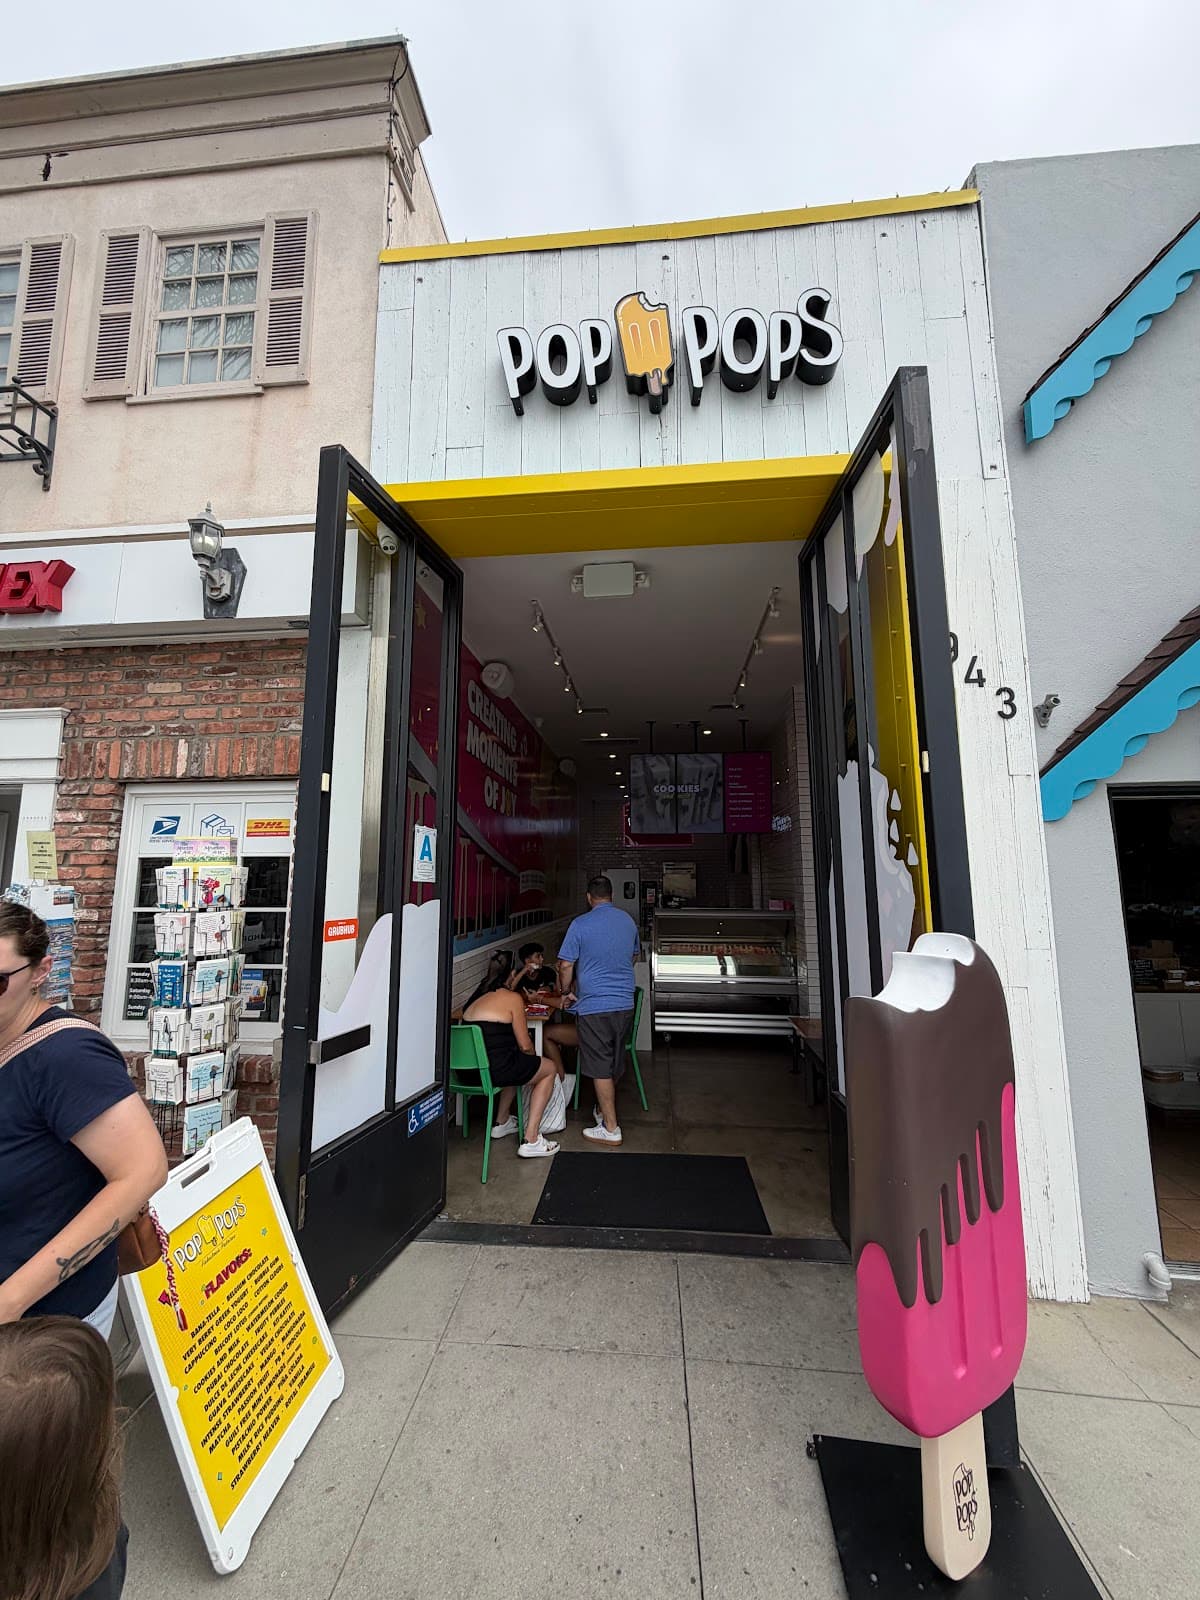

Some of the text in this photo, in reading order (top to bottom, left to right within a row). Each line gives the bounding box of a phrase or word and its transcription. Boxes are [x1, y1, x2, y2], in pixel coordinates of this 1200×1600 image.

[496, 287, 844, 408] POP POPS
[0, 559, 76, 614] EX
[466, 719, 518, 788] MOMENTS
[467, 679, 517, 753] CREATING
[253, 821, 286, 829] DHL
[484, 775, 518, 817] OF JOY
[653, 784, 701, 793] COOKIES
[419, 835, 433, 861] A
[327, 924, 356, 937] GRUBHUB
[173, 1196, 247, 1273] POP POPS
[182, 1342, 197, 1361] VERY
[197, 1324, 214, 1345] BERRY
[214, 1307, 230, 1327] GREEK
[230, 1287, 248, 1309] YOGURT
[254, 1266, 269, 1285] BUBBLE
[269, 1255, 279, 1268] GUM
[183, 1335, 217, 1375] CAPPUCCINO
[223, 1313, 236, 1331] COCO
[236, 1300, 248, 1317] LOCO
[253, 1278, 269, 1298] COTTON
[269, 1262, 283, 1280] CLOUDS
[190, 1304, 220, 1338] BANA-TELLA
[225, 1278, 246, 1302] BELGIUM
[246, 1255, 268, 1280] CHOCOLATE
[193, 1365, 215, 1394] COOKIES
[215, 1351, 227, 1368] AND
[227, 1336, 240, 1354] MILK
[245, 1297, 274, 1332] WATERMELON
[273, 1280, 288, 1300] COOLER
[213, 1315, 247, 1355] BISCOFF LOTUS
[200, 1417, 222, 1448] INTENSE
[222, 1376, 253, 1420] STRAWBERRY
[259, 1346, 276, 1371] MANGO
[281, 1309, 305, 1343] MANGONADA
[203, 1389, 220, 1412] DULCE
[220, 1380, 227, 1392] DE
[227, 1362, 242, 1382] LECHE
[242, 1331, 267, 1365] CHEESECAKE
[206, 1370, 223, 1394] DUBAI
[223, 1339, 249, 1374] CHOCOLATE
[254, 1315, 269, 1336] FRUITY
[269, 1296, 285, 1318] PEBBLES
[207, 1395, 226, 1423] GUAVA
[226, 1360, 254, 1398] CHEESECAKE
[259, 1335, 274, 1357] VEGAN
[274, 1309, 295, 1338] CHOCOLATE
[208, 1421, 231, 1454] MATCHA
[237, 1386, 257, 1415] PASSION
[257, 1369, 269, 1389] FRUIT
[274, 1354, 281, 1365] PB
[286, 1320, 306, 1350] CHOCOLATE
[225, 1361, 285, 1448] GUILT FREE MINT LEMONADE
[230, 1360, 315, 1491] STRAWBERRY HEAVEN ROYAL TIRAMISU
[231, 1417, 256, 1455] PISTACHIO
[256, 1394, 272, 1420] POWER
[277, 1371, 288, 1390] PIÑA
[288, 1351, 302, 1375] COLADA
[237, 1437, 253, 1463] MILKY
[253, 1421, 264, 1440] RICE
[264, 1393, 284, 1424] PUDDING
[288, 1363, 304, 1388] VANILLA
[955, 1470, 973, 1504] POP
